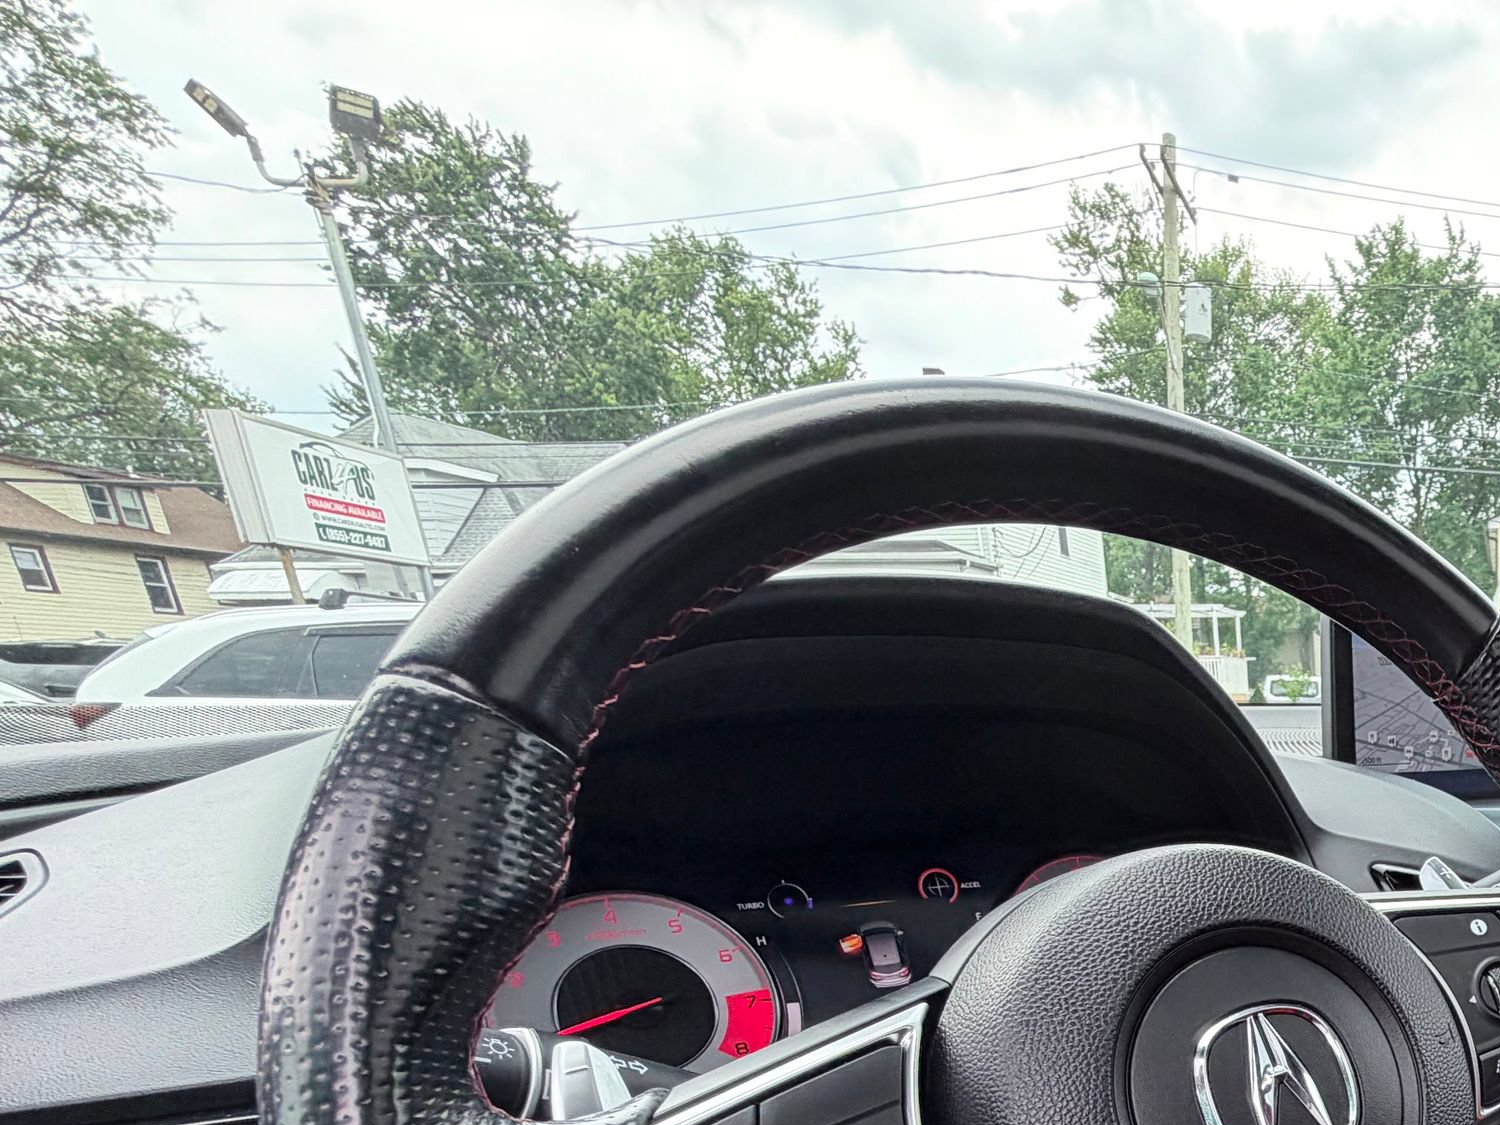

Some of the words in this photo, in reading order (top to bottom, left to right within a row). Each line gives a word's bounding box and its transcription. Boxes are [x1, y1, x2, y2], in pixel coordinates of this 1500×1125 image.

[960, 881, 981, 890] ACCEL
[737, 901, 765, 911] TURBO
[603, 911, 617, 924] 4
[668, 919, 683, 933] 5
[756, 936, 767, 947] H
[719, 950, 733, 962] 6
[734, 1041, 751, 1056] 8
